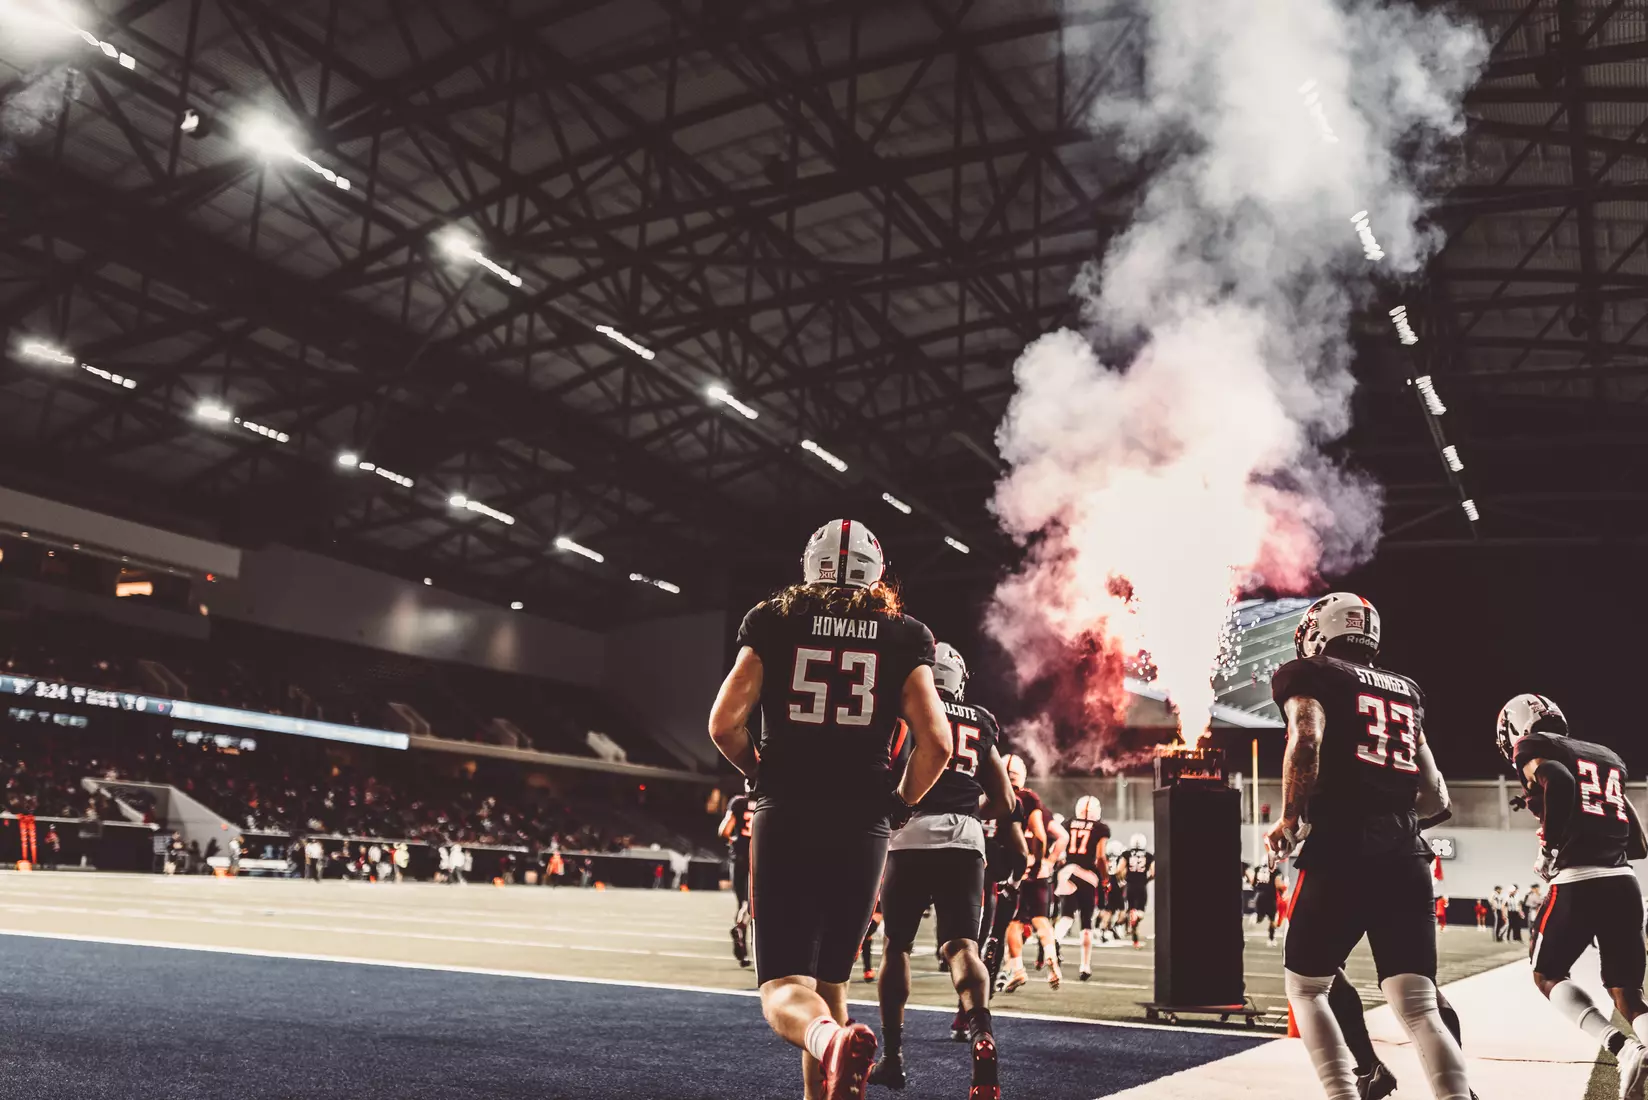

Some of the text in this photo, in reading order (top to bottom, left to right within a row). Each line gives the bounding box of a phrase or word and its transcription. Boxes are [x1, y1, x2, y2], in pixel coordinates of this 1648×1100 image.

[812, 615, 878, 640] HOWARD
[787, 646, 878, 727] 53
[1354, 667, 1412, 697] STRINGER
[1357, 693, 1420, 773] 33
[1577, 759, 1629, 823] 24
[1068, 829, 1091, 855] 17
